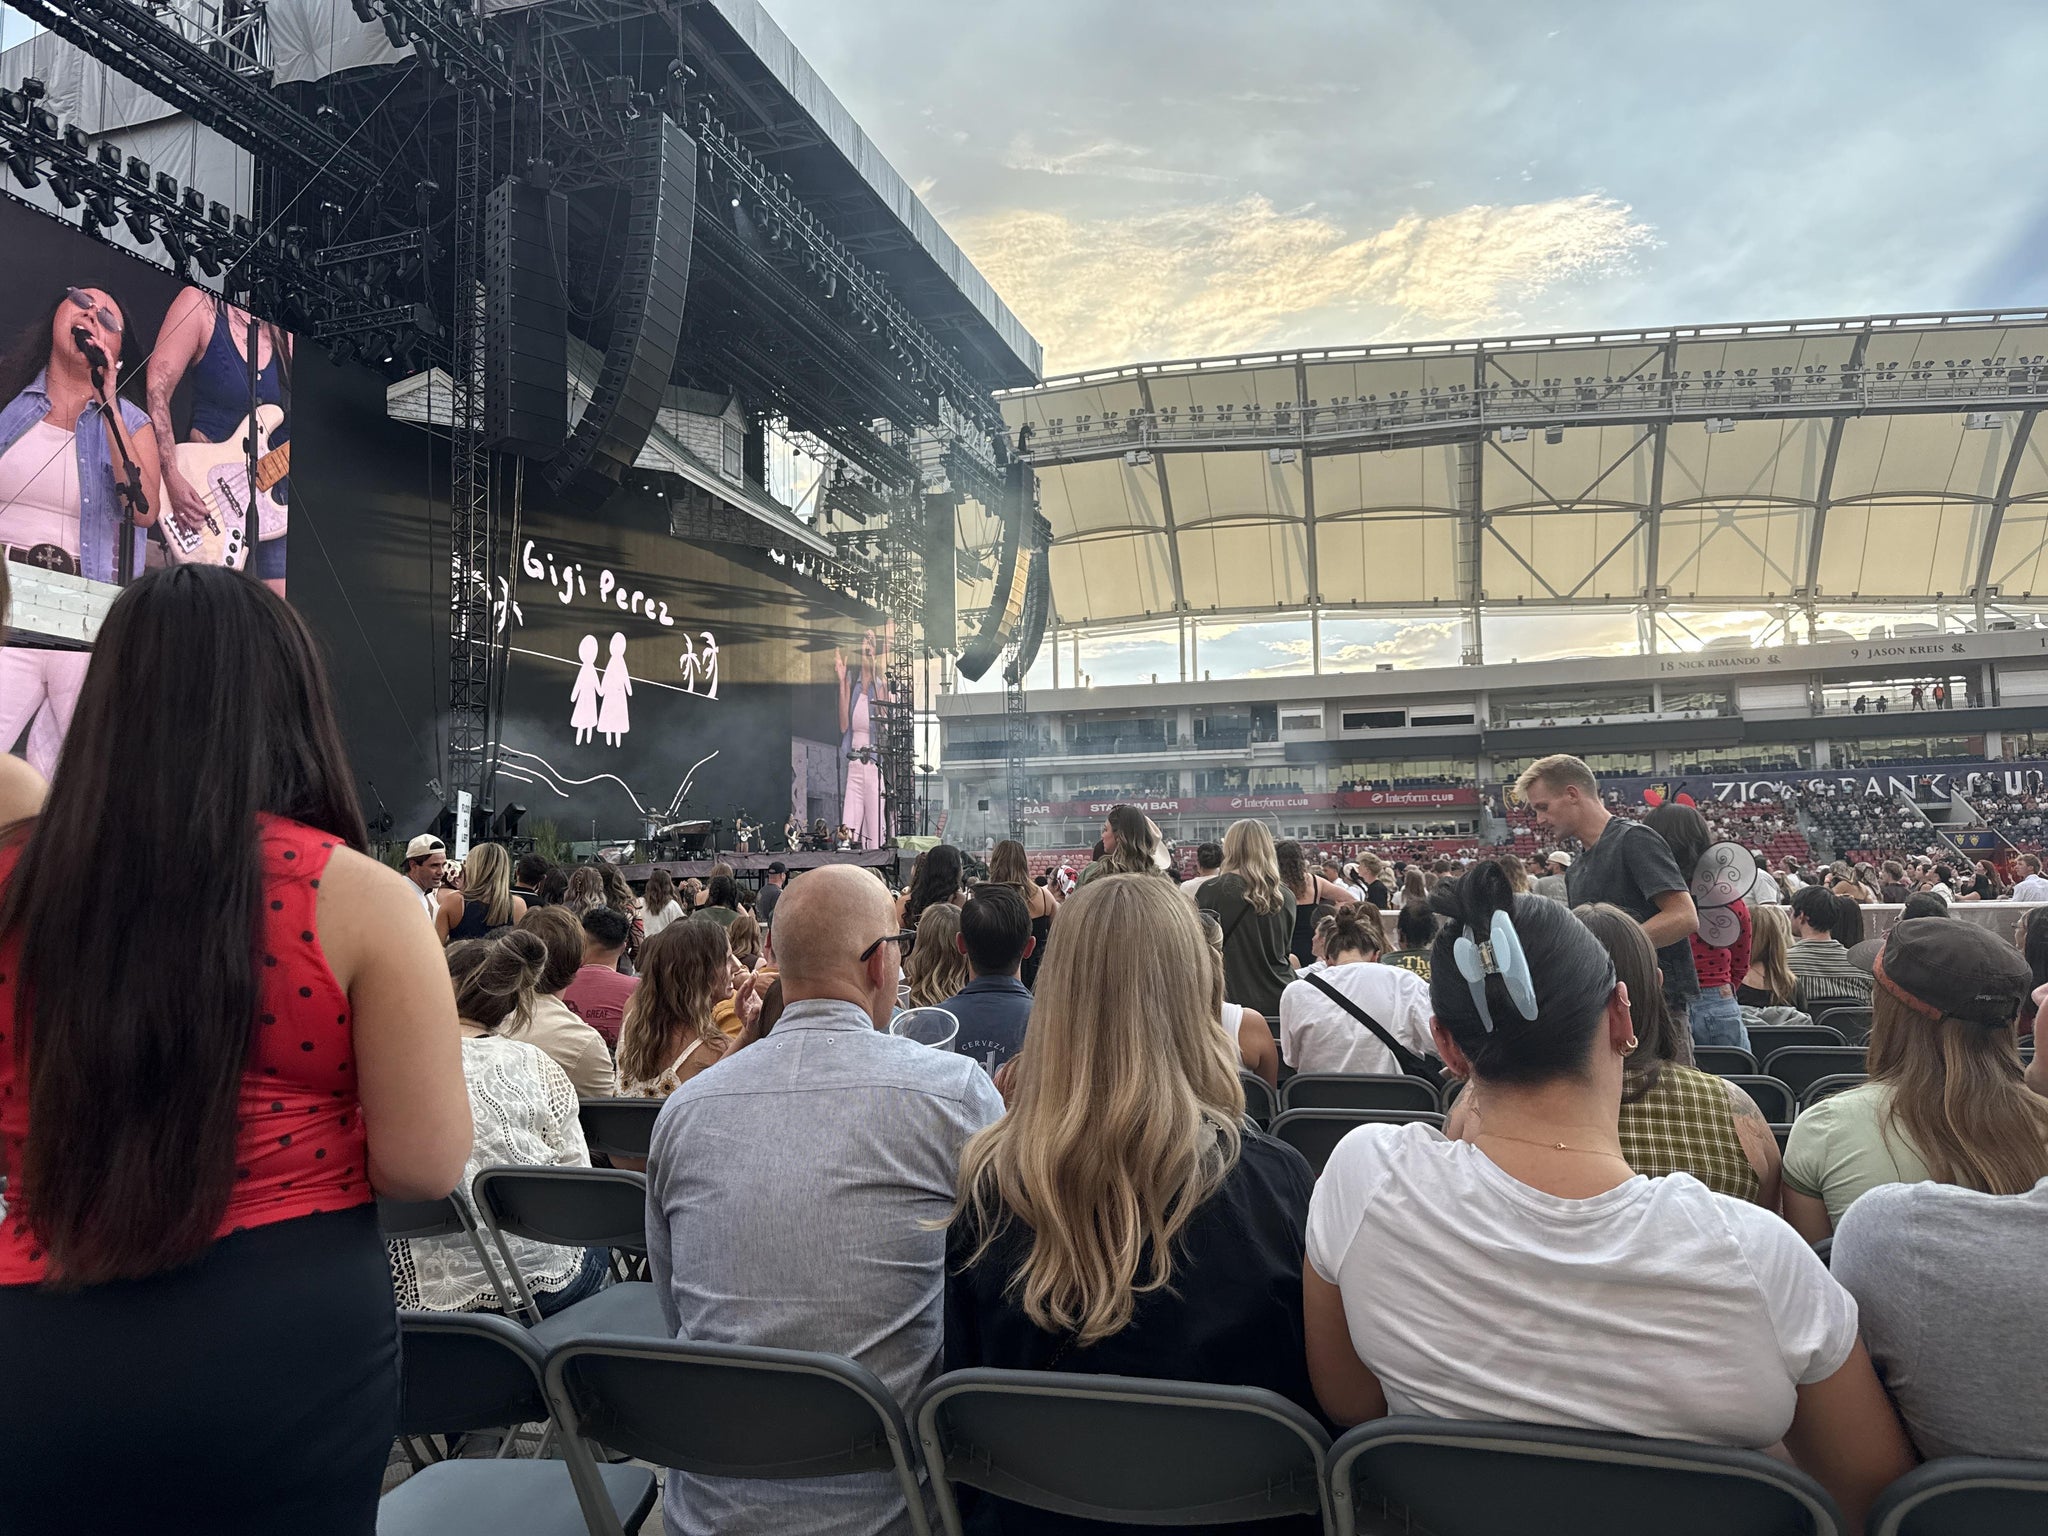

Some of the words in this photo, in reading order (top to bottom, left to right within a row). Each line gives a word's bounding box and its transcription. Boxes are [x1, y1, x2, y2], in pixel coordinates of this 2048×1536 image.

[523, 540, 586, 604] Gigi
[600, 569, 674, 626] Perez
[1851, 649, 1859, 659] 9
[1867, 646, 1906, 659] JASON
[1909, 644, 1944, 655] KREIS
[1660, 661, 1674, 672] 18
[1678, 659, 1705, 670] NICK
[1707, 656, 1760, 668] RIMANDO
[1244, 797, 1285, 809] Interform
[1385, 792, 1428, 804] Interform
[1431, 793, 1454, 801] CLUB
[1023, 805, 1050, 814] BAR
[1150, 801, 1179, 810] BAR
[961, 1039, 1006, 1054] CERVEZA
